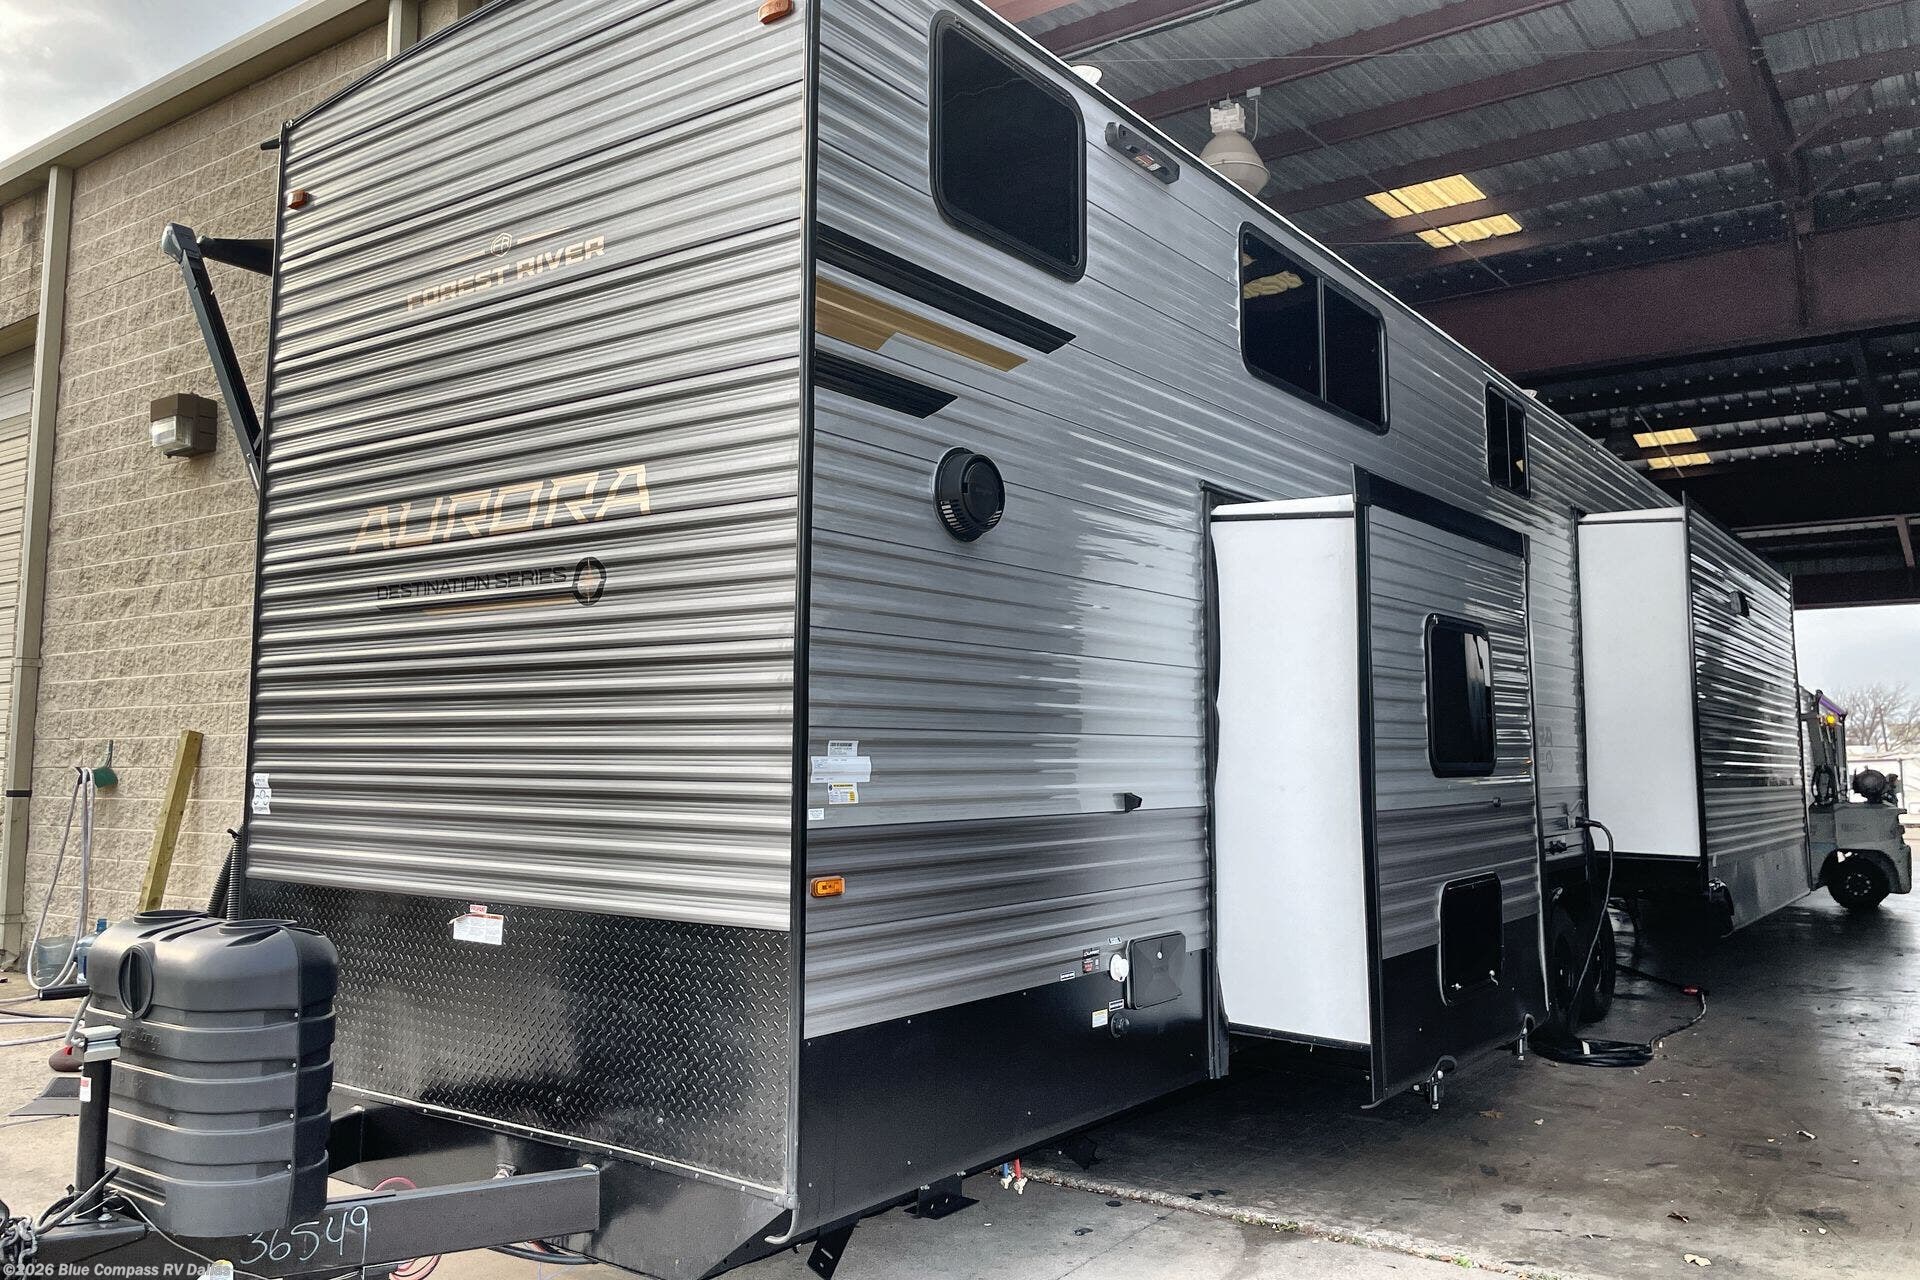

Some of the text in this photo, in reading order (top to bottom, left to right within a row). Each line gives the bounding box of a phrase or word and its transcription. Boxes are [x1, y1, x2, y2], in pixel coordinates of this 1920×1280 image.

[406, 235, 606, 312] FOREST RIVER
[348, 464, 652, 554] AURORA
[376, 566, 567, 600] DESTINATION SERIES
[240, 1206, 369, 1265] 36549
